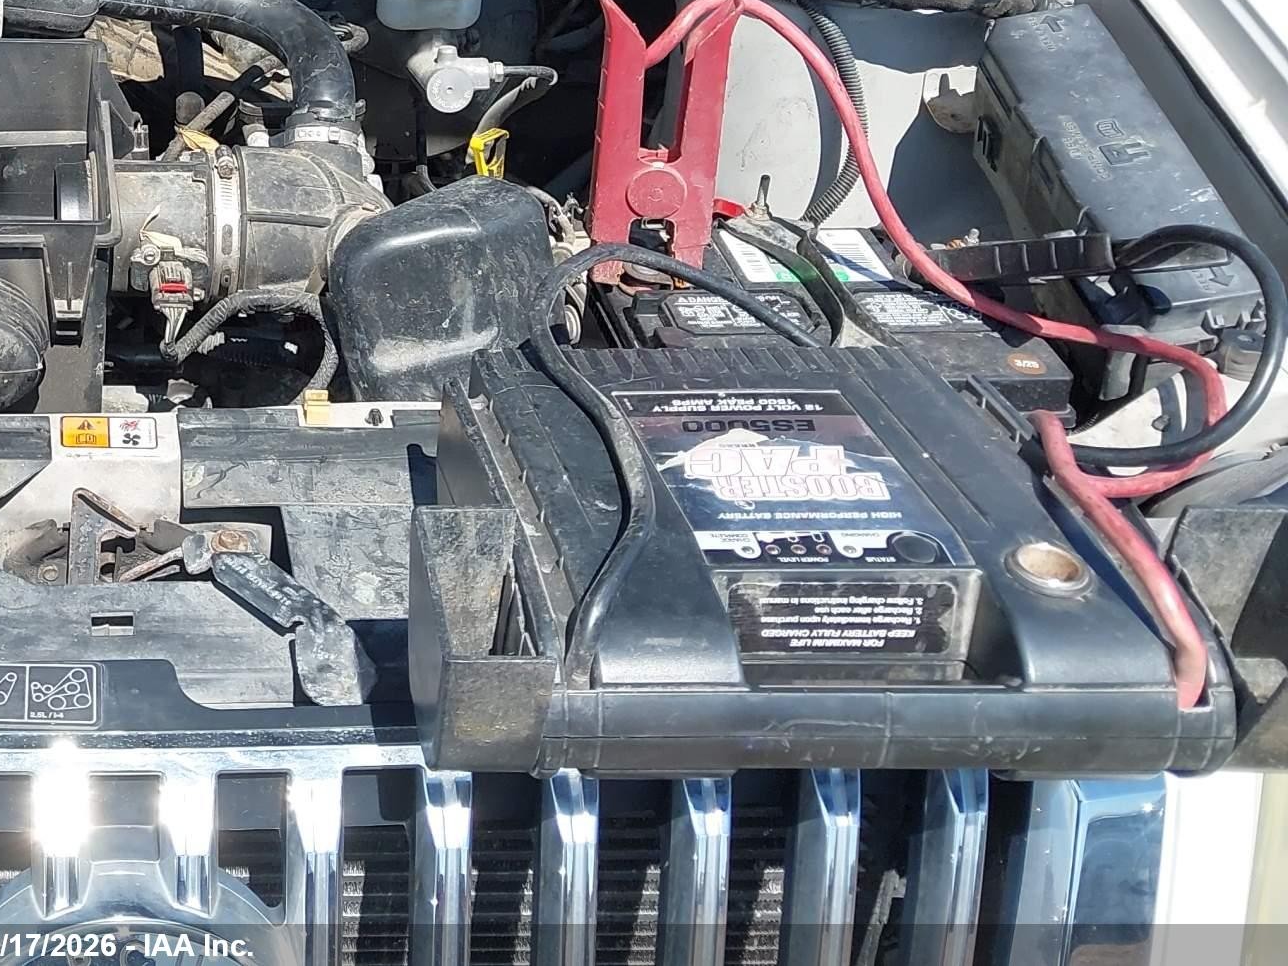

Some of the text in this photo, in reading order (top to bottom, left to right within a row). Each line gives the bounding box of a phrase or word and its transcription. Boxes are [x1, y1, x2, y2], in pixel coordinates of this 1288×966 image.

[652, 404, 707, 412] SUPPLY
[681, 419, 816, 433] ES5000
[685, 445, 845, 477] PAC
[717, 474, 892, 501] BOOSTER
[717, 512, 771, 520] BATTERY
[849, 596, 885, 604] charging
[886, 597, 914, 605] Follow
[873, 606, 913, 614] Recharge
[760, 615, 799, 623] purchase
[822, 615, 871, 624] immediately
[872, 616, 913, 624] Recharge
[761, 629, 916, 637] KEEP BATTERY FULLY CHARGED
[789, 639, 885, 647] FOR MAXIMUM LIFE
